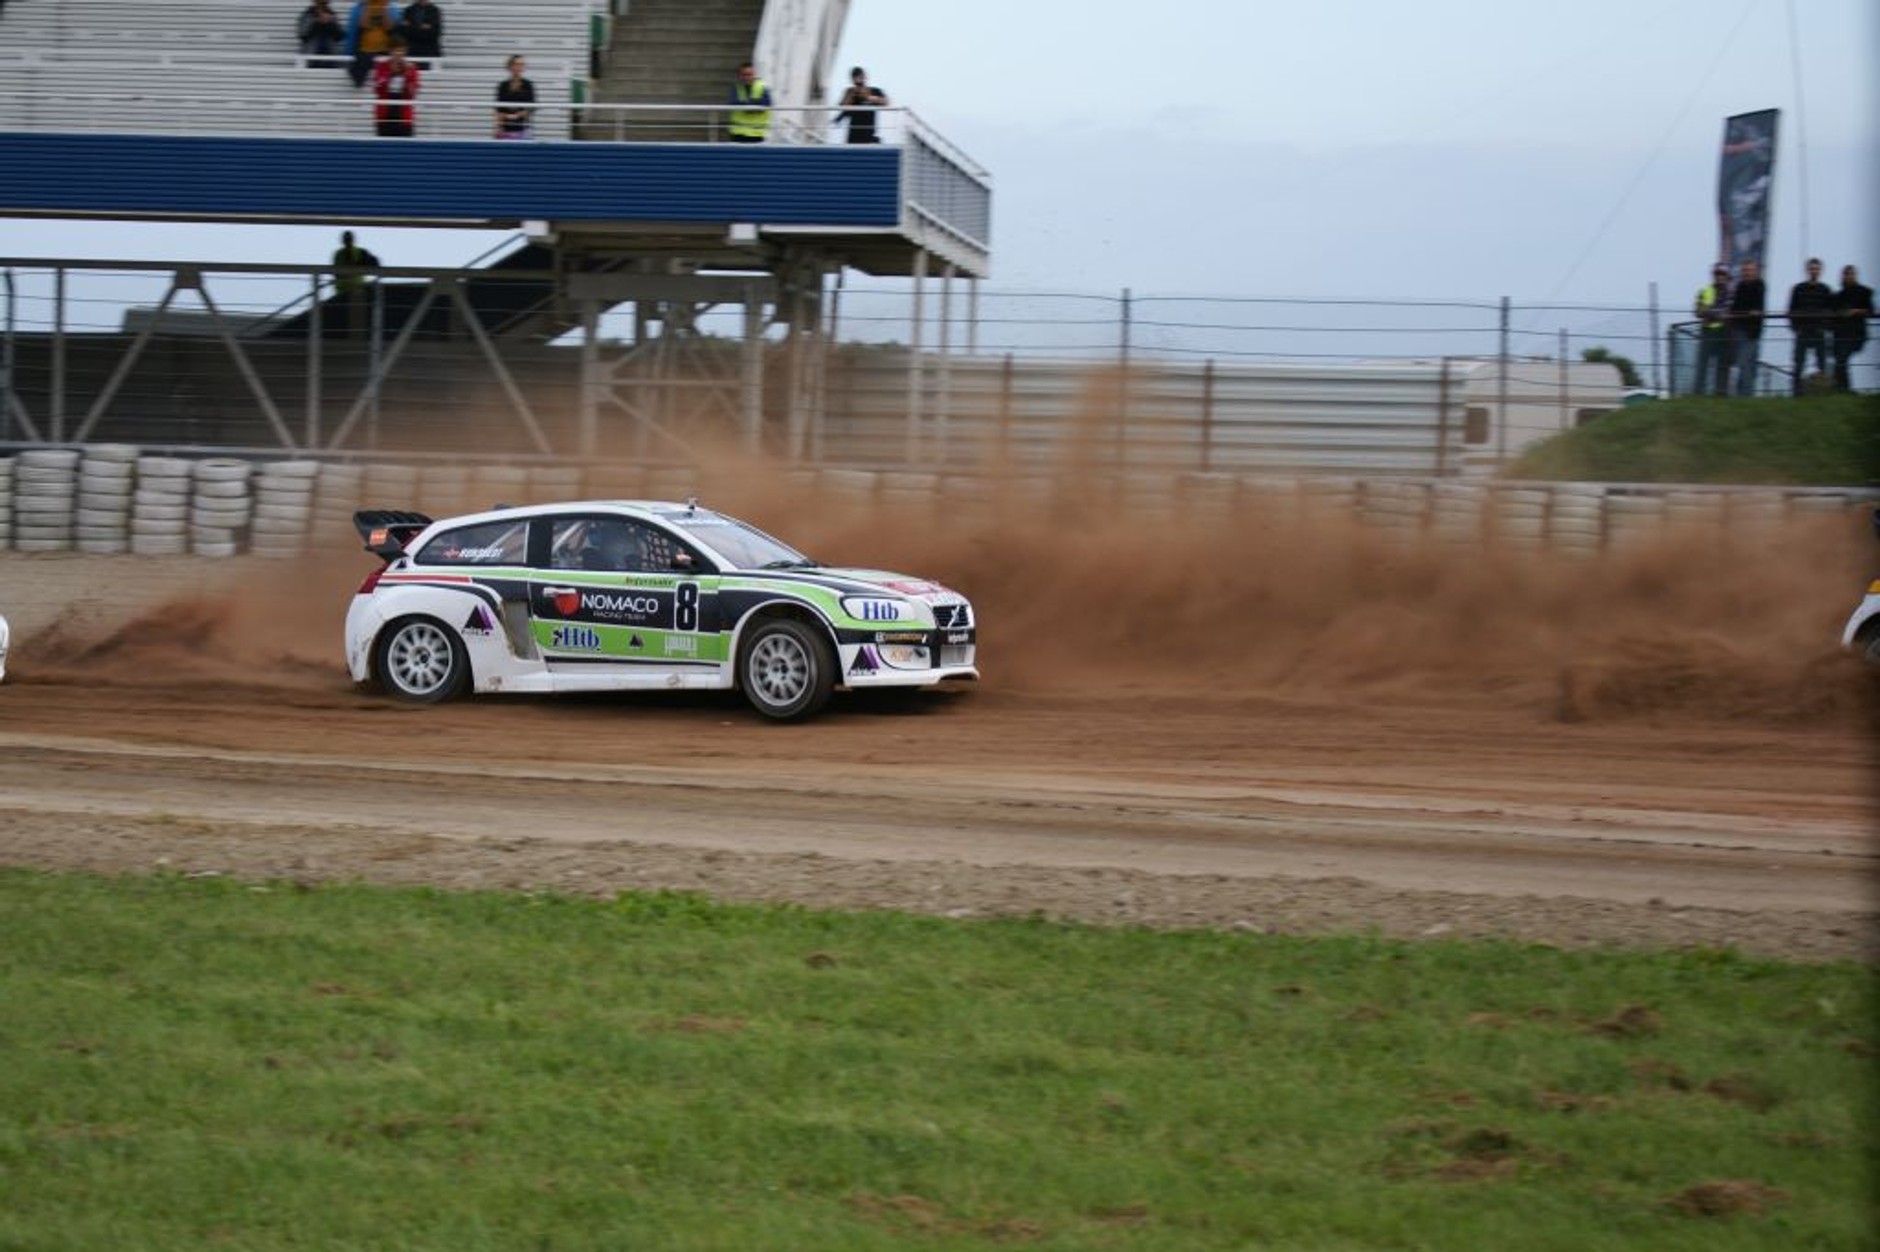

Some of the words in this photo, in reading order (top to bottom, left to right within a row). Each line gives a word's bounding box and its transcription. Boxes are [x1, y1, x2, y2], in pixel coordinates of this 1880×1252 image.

[581, 594, 659, 613] NOMACO
[677, 583, 698, 631] 8
[863, 602, 899, 620] Htb
